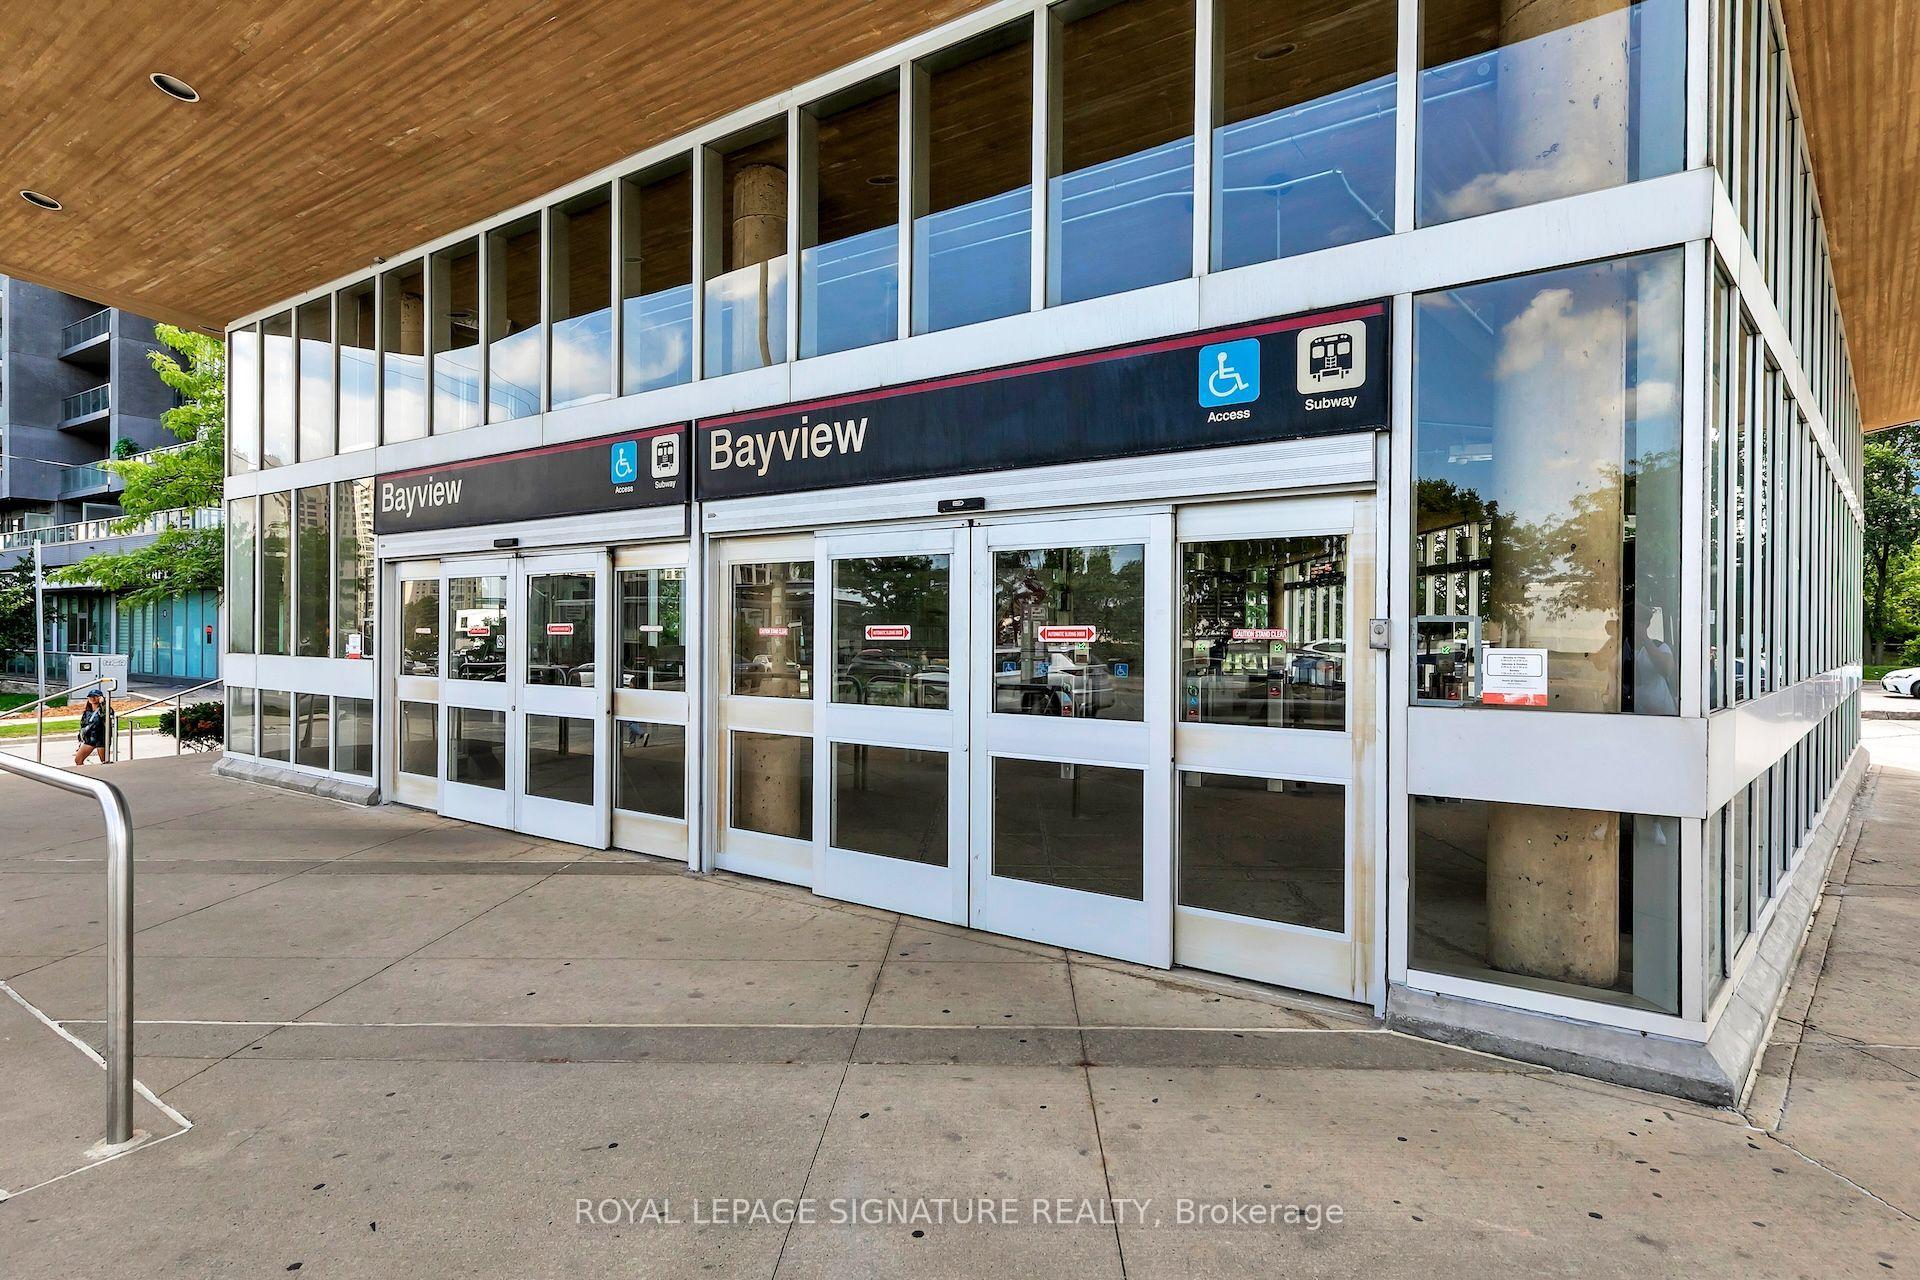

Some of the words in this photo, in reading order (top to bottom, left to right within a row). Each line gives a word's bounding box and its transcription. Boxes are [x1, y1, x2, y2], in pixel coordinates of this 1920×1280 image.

[1304, 395, 1358, 411] Subway
[1206, 409, 1251, 423] Access
[710, 415, 869, 477] Bayview
[614, 484, 634, 494] Access
[654, 479, 677, 490] Subway
[381, 476, 463, 518] Bayview
[1234, 630, 1254, 638] CAUTION
[1255, 630, 1270, 638] STAND
[1271, 630, 1287, 638] CLEAR
